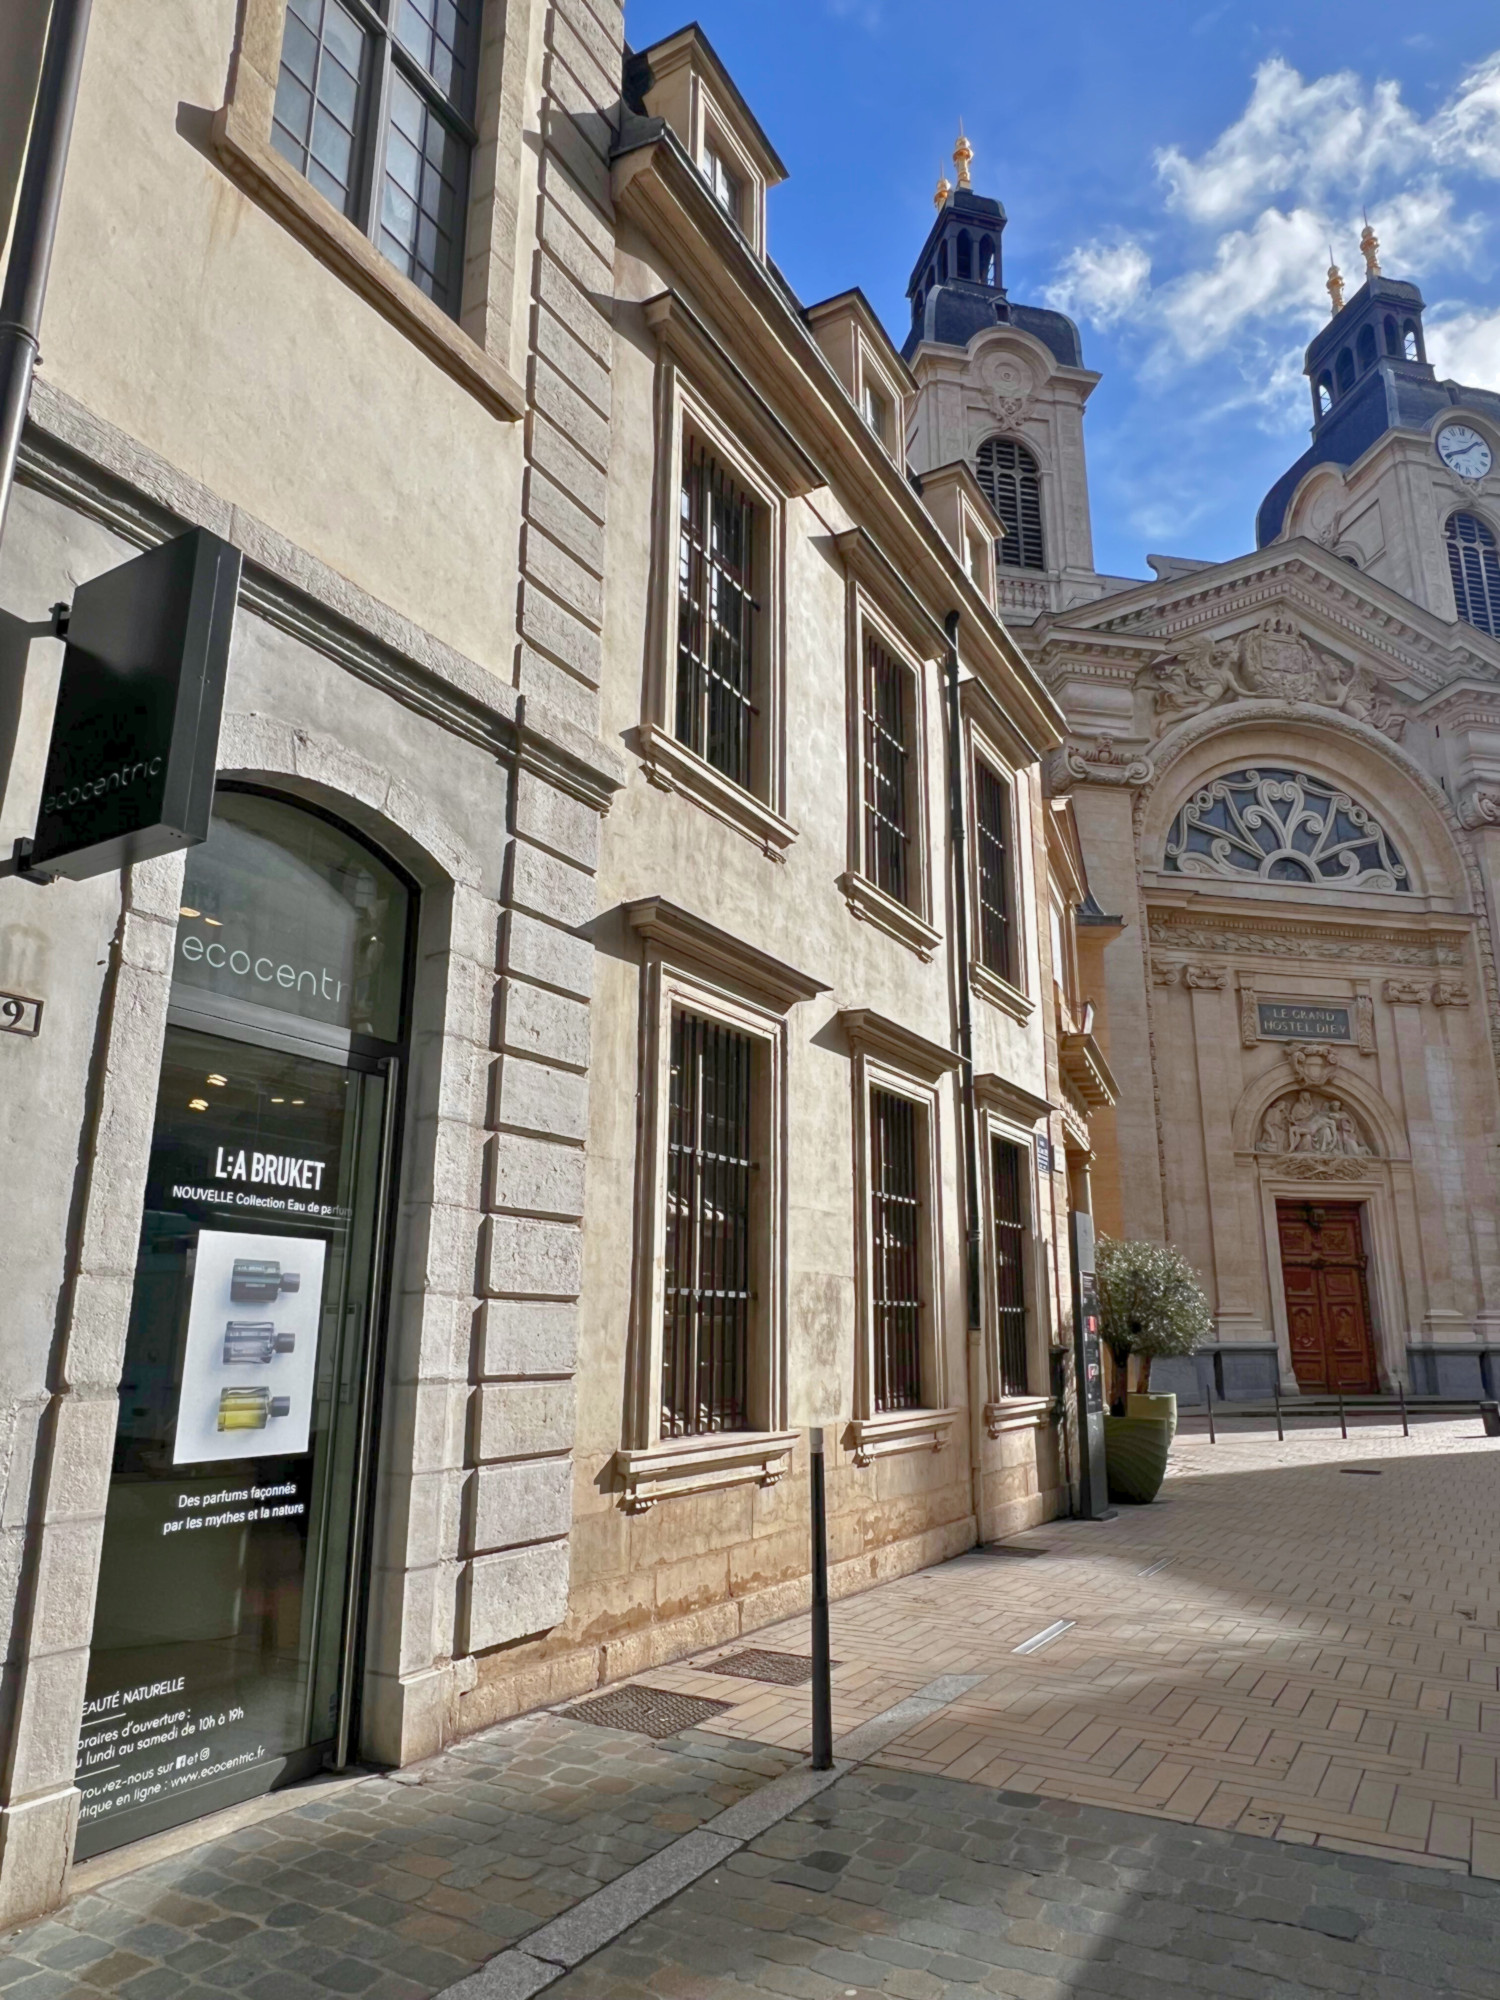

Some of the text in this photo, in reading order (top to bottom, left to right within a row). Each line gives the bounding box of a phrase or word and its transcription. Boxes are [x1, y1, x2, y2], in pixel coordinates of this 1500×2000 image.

[45, 756, 162, 814] ecocentric
[2, 1000, 25, 1028] 9
[1264, 1020, 1313, 1033] HOSTEL
[1273, 1008, 1335, 1022] LE GRAND
[215, 1146, 326, 1191] L:A BRUKET
[172, 1185, 234, 1204] NOUVELLE
[235, 1192, 286, 1211] Collection
[287, 1199, 306, 1212] Eau
[307, 1201, 320, 1213] de
[178, 1482, 296, 1508] Des parfums façonnés
[163, 1503, 305, 1535] par les mythes et la nature
[82, 1677, 185, 1716] EAUTÉ NATURELLE
[77, 1730, 119, 1750] oraires
[121, 1711, 186, 1737] d'ouverture
[86, 1744, 116, 1766] lundi
[118, 1742, 135, 1756] au
[136, 1724, 179, 1751] samedi
[181, 1721, 197, 1737] de
[199, 1714, 217, 1732] 10h
[228, 1706, 245, 1723] 19h
[115, 1793, 131, 1806] en
[133, 1783, 162, 1803] ligne
[171, 1745, 265, 1787] www.ecocentric.fr
[157, 1761, 175, 1776] sur
[186, 1751, 199, 1766] et
